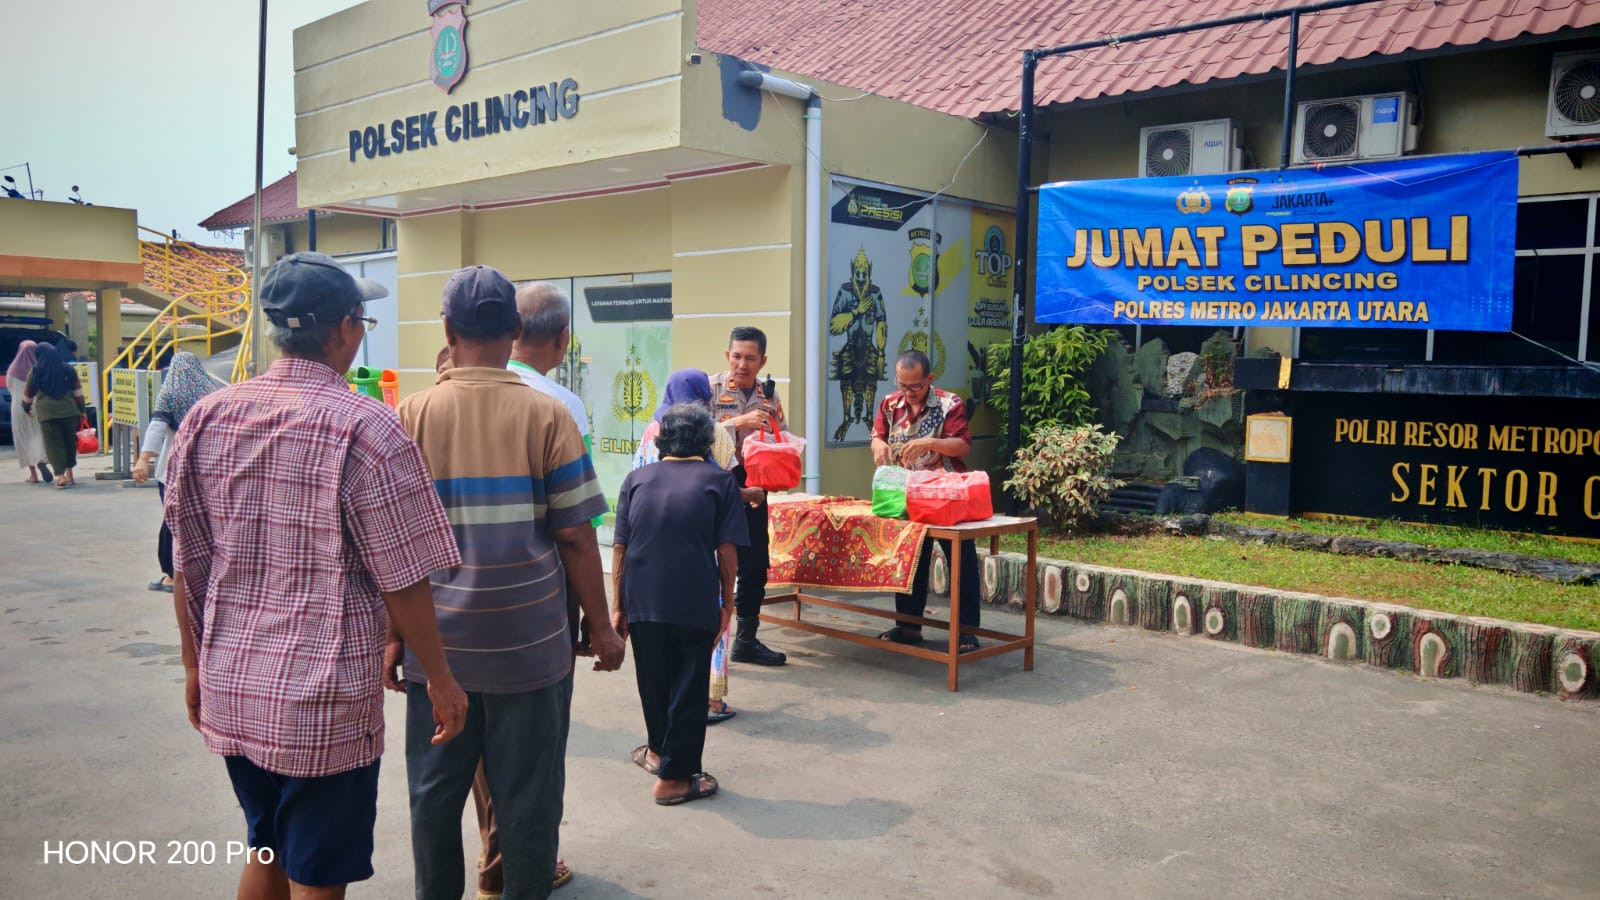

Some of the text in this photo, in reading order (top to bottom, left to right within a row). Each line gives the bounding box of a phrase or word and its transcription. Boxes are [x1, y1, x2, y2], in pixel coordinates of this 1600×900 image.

[349, 77, 579, 162] POLSEK CILINCING
[1377, 106, 1396, 115] AQUA
[1066, 215, 1469, 269] JUMAT PEDULI
[975, 250, 1012, 277] TOP
[1137, 272, 1399, 291] POLSEK CILINCING
[1113, 300, 1429, 322] POLRES METRO JAKARTA UTARA
[1334, 418, 1397, 445] POLRI
[1404, 421, 1479, 449] RESOR
[1391, 462, 1559, 517] SEKTOR
